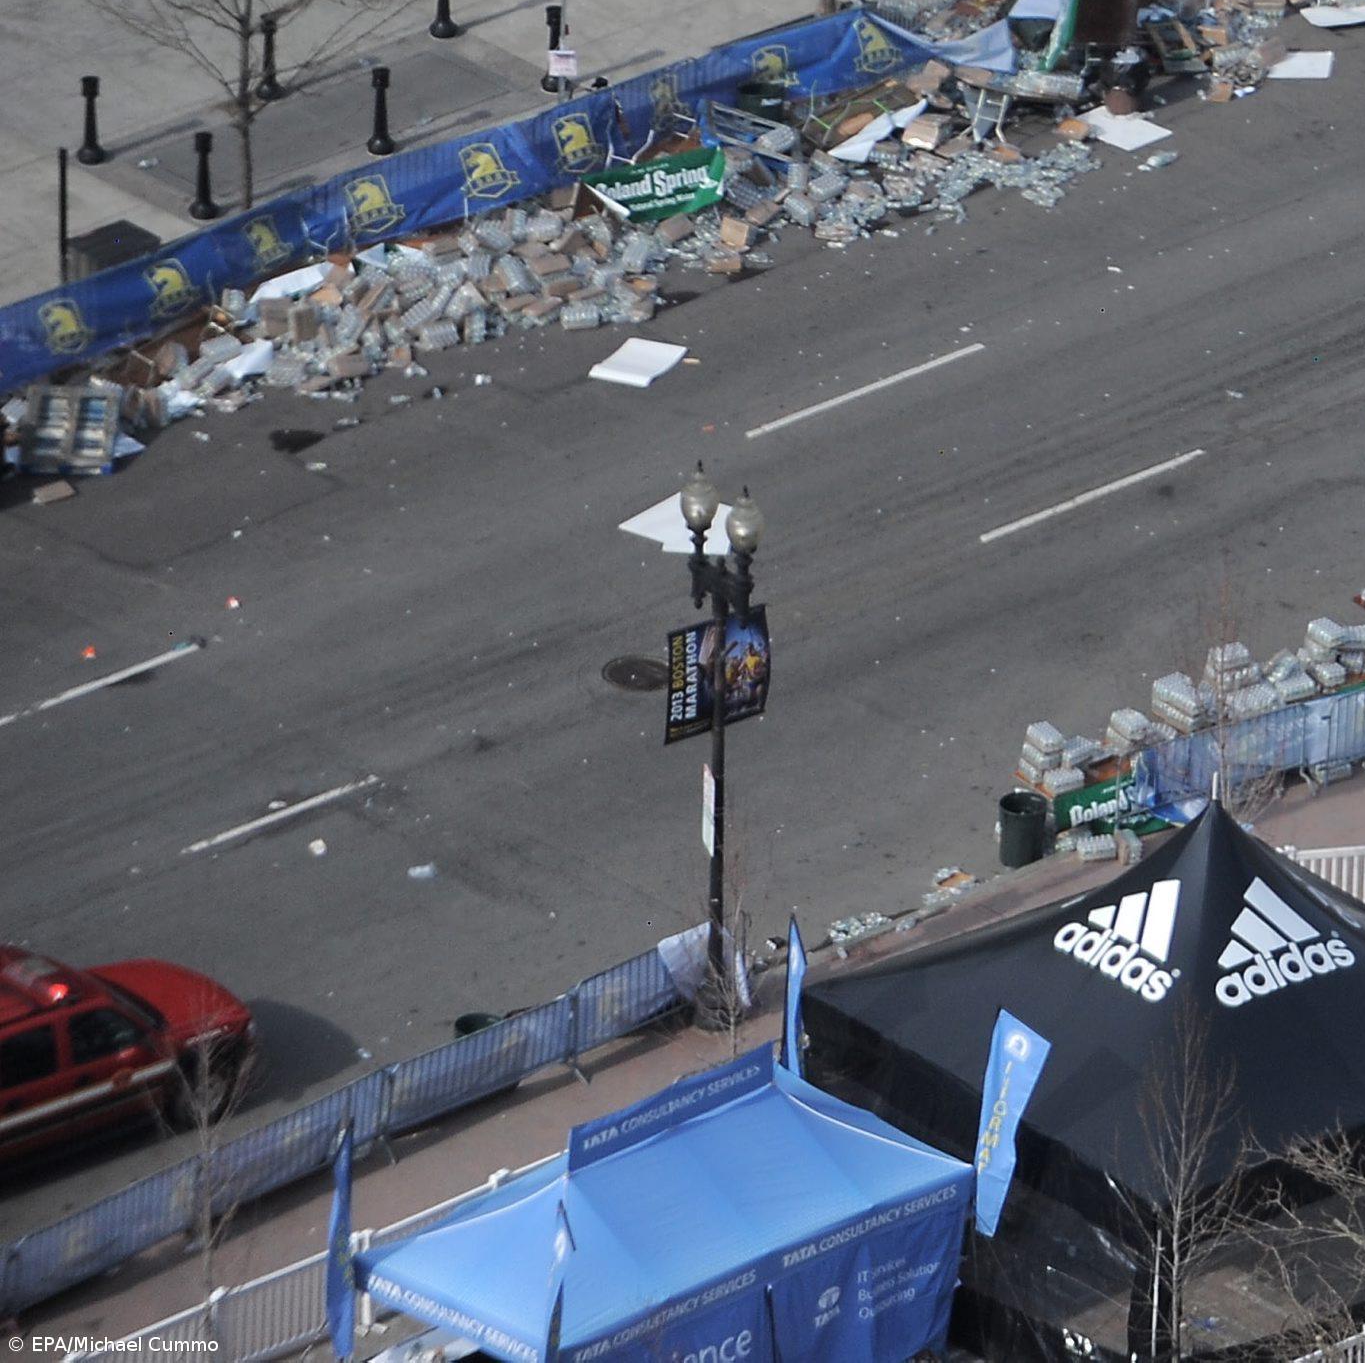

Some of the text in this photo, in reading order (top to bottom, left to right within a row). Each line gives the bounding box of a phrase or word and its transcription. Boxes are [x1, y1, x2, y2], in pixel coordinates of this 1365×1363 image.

[670, 635, 685, 722] 2013 BOSTON
[685, 631, 698, 719] MARATHON
[1053, 921, 1174, 1003] adidas
[1215, 938, 1357, 1007] adidas
[583, 1126, 619, 1151] TATA
[620, 1087, 706, 1132] CONSULTANCY
[783, 1183, 957, 1269] TATA CONSULTANCY SERVICES
[367, 1274, 403, 1303] TATA
[573, 1338, 611, 1363] TATA
